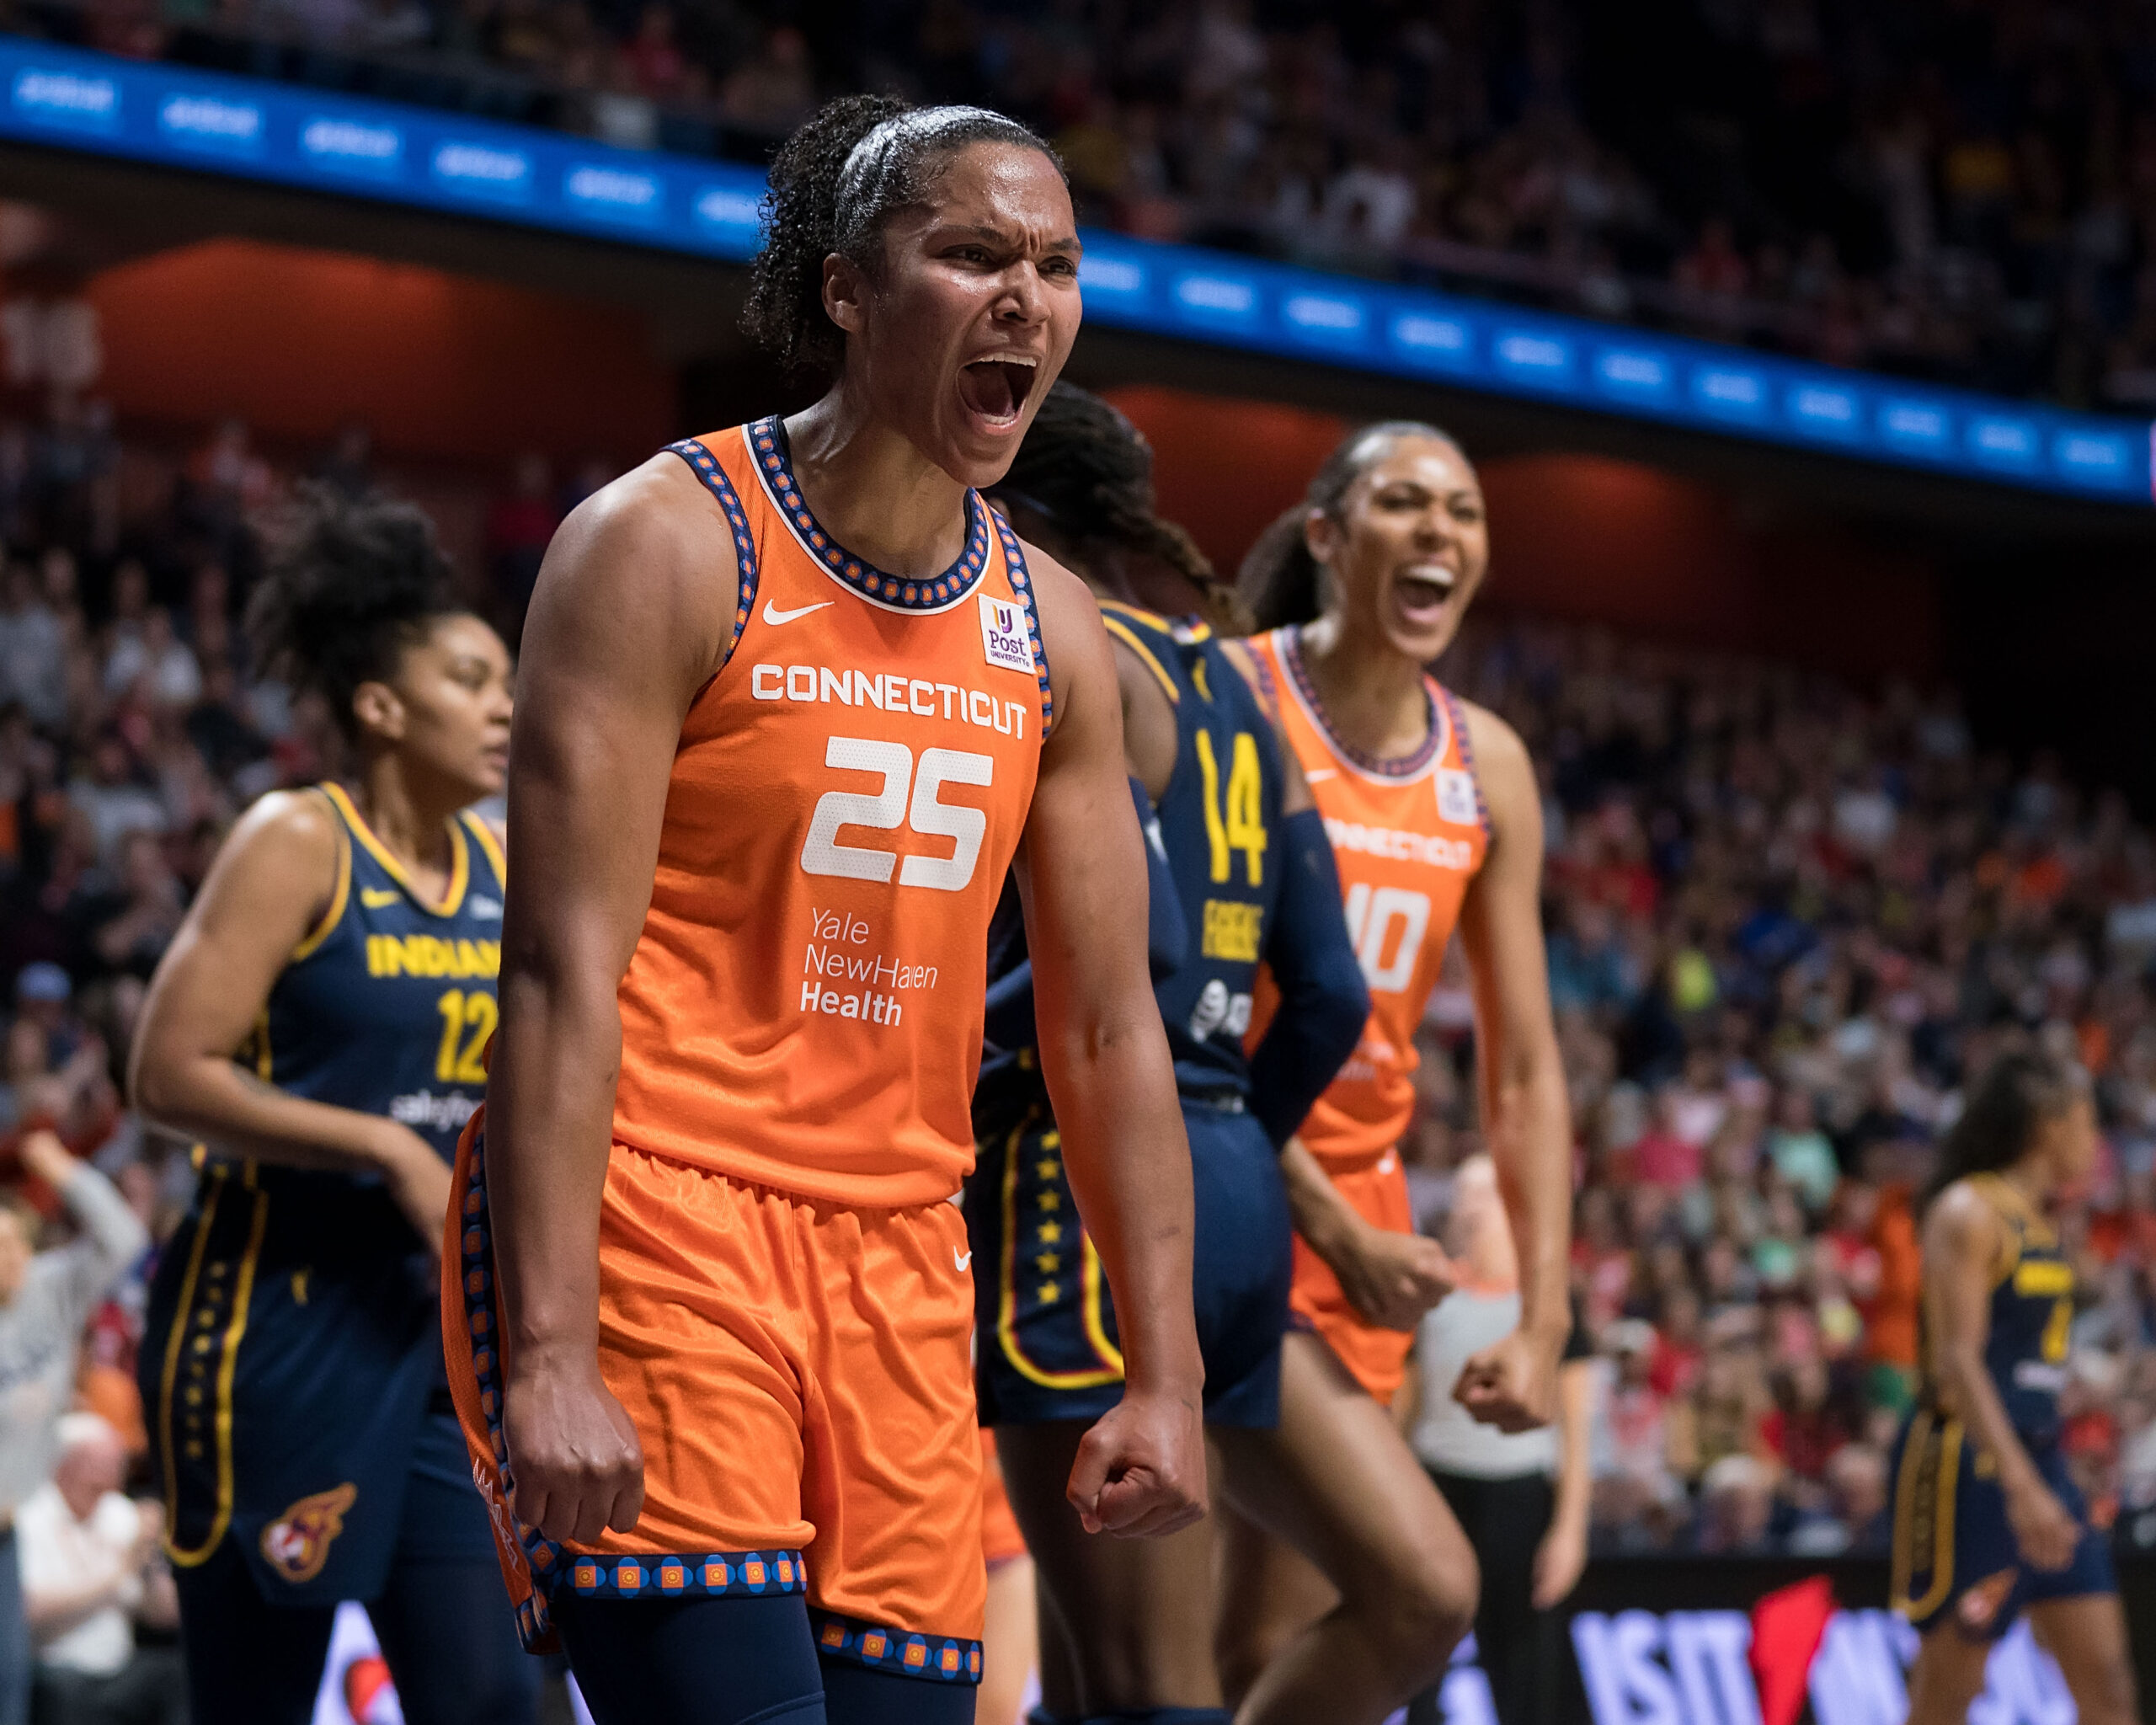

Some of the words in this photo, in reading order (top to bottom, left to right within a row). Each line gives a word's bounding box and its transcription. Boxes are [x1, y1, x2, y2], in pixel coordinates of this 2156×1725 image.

[989, 628, 1027, 656] Post
[990, 650, 1027, 665] UNIVERSITY
[752, 664, 1027, 740] CONNECTICUT
[801, 736, 994, 891] 25
[1196, 729, 1267, 887] 14
[812, 907, 869, 944] Yale
[1345, 883, 1431, 992] 10
[804, 943, 938, 990] NewHaven
[800, 980, 902, 1027] Health
[435, 987, 499, 1084] 12
